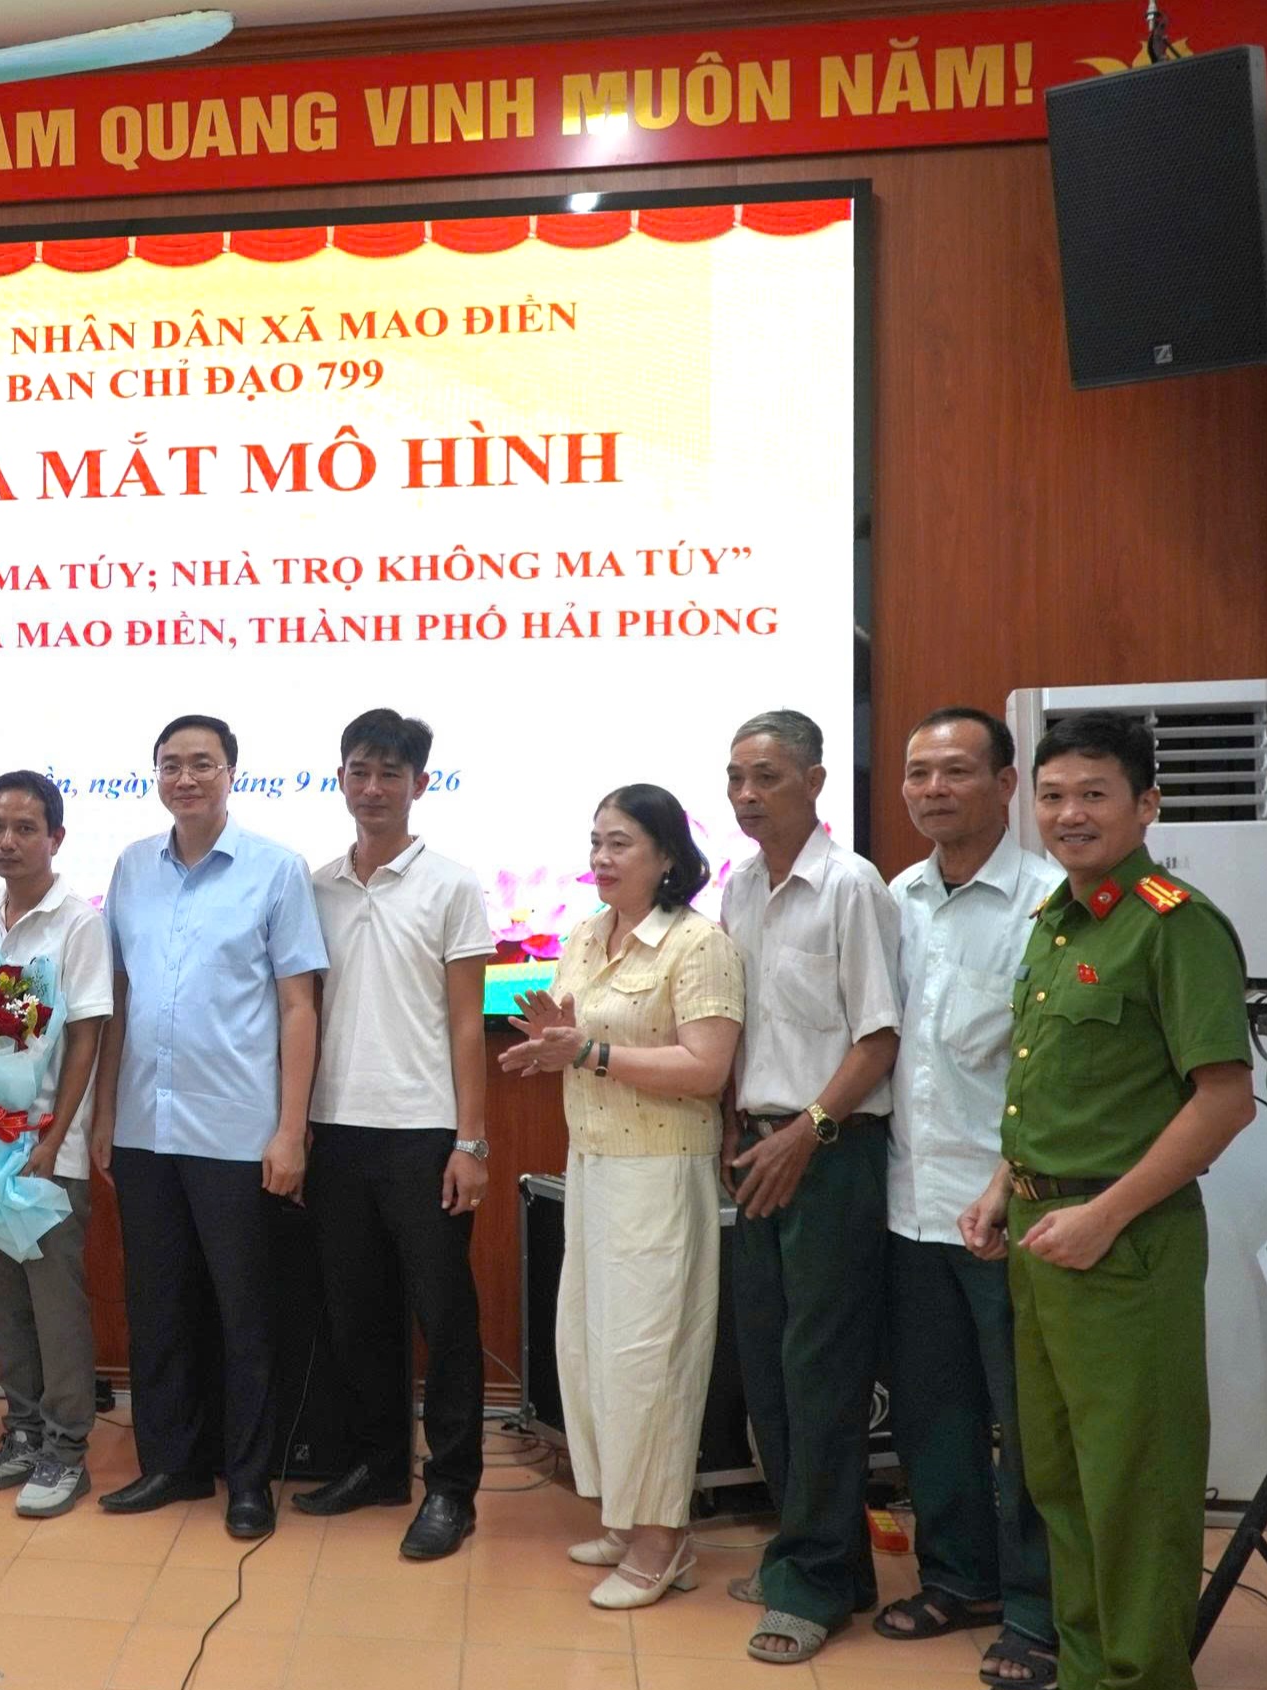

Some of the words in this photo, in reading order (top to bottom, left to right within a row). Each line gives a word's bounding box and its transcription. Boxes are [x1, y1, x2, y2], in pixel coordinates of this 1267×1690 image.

[100, 91, 337, 171] QUANG
[364, 77, 535, 147] VINH
[561, 51, 791, 137] MUÔN
[820, 37, 1033, 118] NĂM!
[11, 315, 135, 354] NHÂN
[153, 310, 244, 349] DÂN
[262, 306, 322, 344] XÃ
[339, 308, 449, 340] MAO
[461, 293, 578, 335] ĐIỀN
[8, 372, 93, 402] BAN
[109, 358, 189, 398] CHỈ
[204, 362, 303, 402] ĐẠO
[318, 359, 384, 390] 799
[37, 432, 217, 500] MẮT
[242, 425, 377, 494] MÔ
[404, 420, 622, 489] HÌNH
[60, 554, 157, 592] TÚY;
[172, 551, 261, 587] NHÀ
[273, 556, 363, 591] TRỌ
[378, 544, 539, 582] KHÔNG
[557, 551, 624, 578] MA
[636, 540, 752, 576] TÚY”
[17, 620, 112, 648] MAO
[125, 611, 237, 648] ĐIỀN,
[248, 608, 402, 644] THÀNH
[416, 604, 507, 641] PHỐ
[522, 602, 601, 639] HẢI
[618, 601, 778, 637] PHÒNG
[88, 772, 154, 800] ngày
[233, 771, 286, 798] áng
[295, 770, 311, 792] 9
[427, 770, 462, 792] 26
